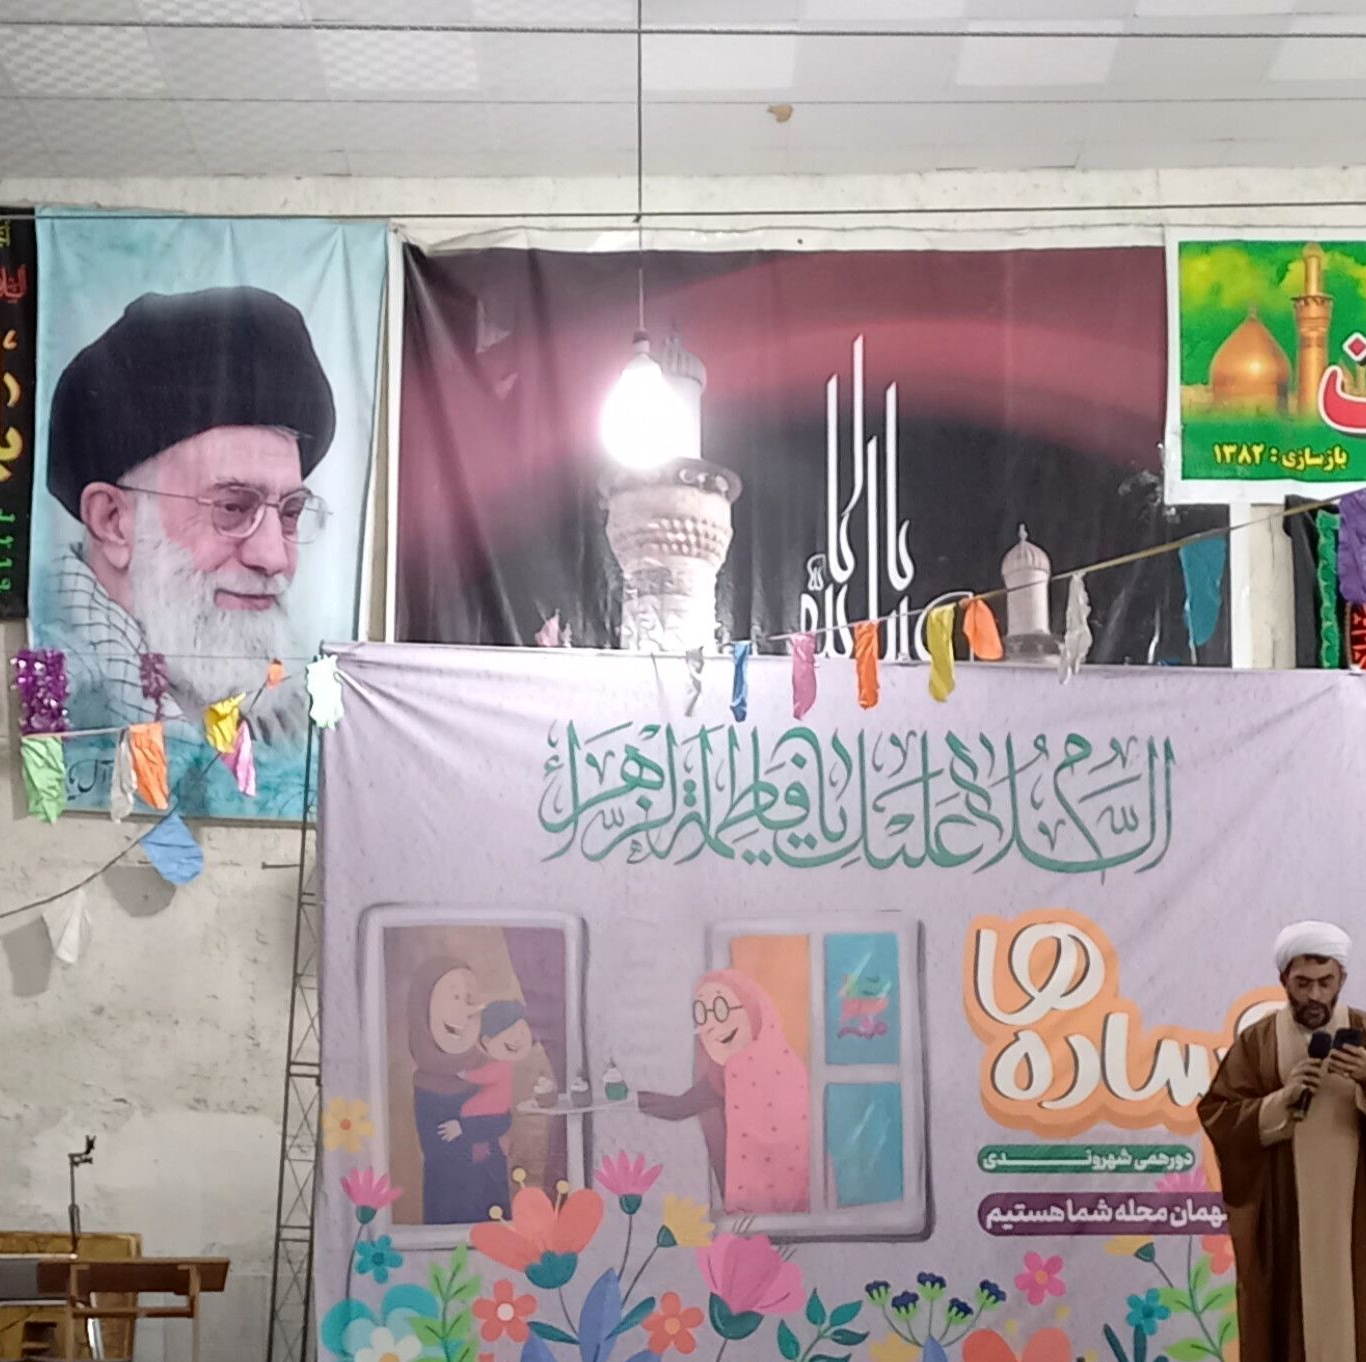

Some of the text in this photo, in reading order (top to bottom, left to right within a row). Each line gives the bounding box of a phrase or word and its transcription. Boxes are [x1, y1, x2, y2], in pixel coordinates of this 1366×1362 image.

[986, 1202, 1066, 1231] هستیم
[1066, 1199, 1114, 1223] شما
[1115, 1199, 1169, 1223] محله
